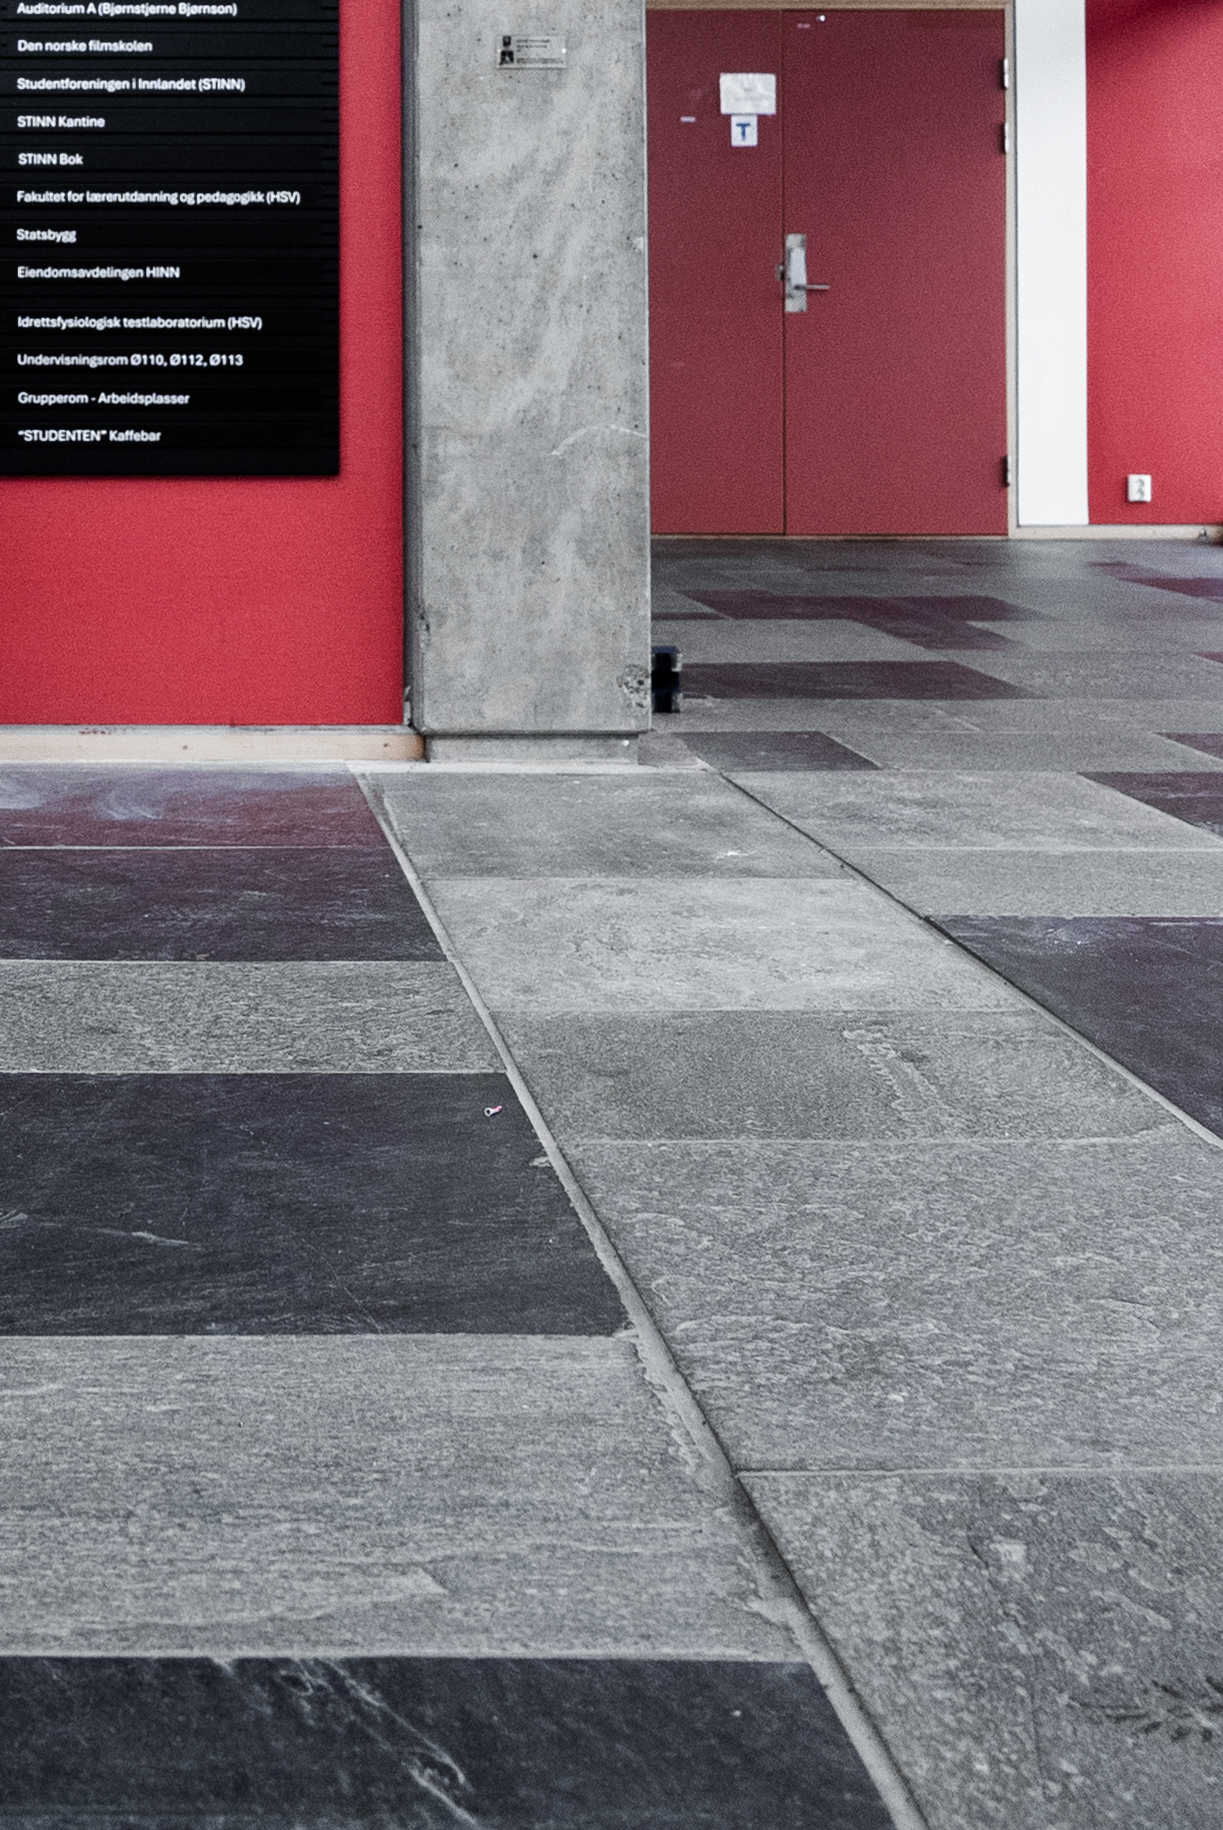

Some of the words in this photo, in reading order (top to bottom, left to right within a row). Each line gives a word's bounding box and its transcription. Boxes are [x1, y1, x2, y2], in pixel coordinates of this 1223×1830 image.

[17, 2, 85, 14] Auditorium
[86, 2, 97, 14] A
[98, 2, 177, 17] (Bjørnstjerne
[178, 2, 237, 17] Bjørnson)
[17, 39, 43, 52] Den
[45, 40, 87, 52] norske
[88, 40, 153, 52] filmskolen
[17, 78, 130, 92] Studentforeningen
[132, 78, 136, 89] i
[138, 78, 196, 90] Innlandet
[198, 78, 245, 92] (STINN)
[17, 116, 56, 127] STINN
[58, 116, 105, 128] Kantine
[735, 122, 751, 141] T
[18, 153, 57, 165] STINN
[59, 153, 83, 165] Bok
[17, 191, 65, 202] Fakultet
[67, 191, 84, 202] for
[86, 191, 178, 205] lærerutdanning
[180, 193, 195, 205] og
[197, 191, 264, 205] pedagogikk
[266, 191, 300, 205] (HSV)
[17, 229, 76, 243] Statsbygg
[18, 266, 144, 281] Eiendomsavdelingen
[146, 266, 180, 278] HINN
[18, 316, 121, 330] Idrettsfysiologisk
[123, 317, 226, 328] testlaboratorium
[227, 316, 262, 330] (HSV)
[17, 354, 129, 368] Undervisningsrom
[18, 392, 89, 405] Grupperom
[98, 392, 190, 406] Arbeidsplasser
[109, 430, 161, 441] Kaffebar
